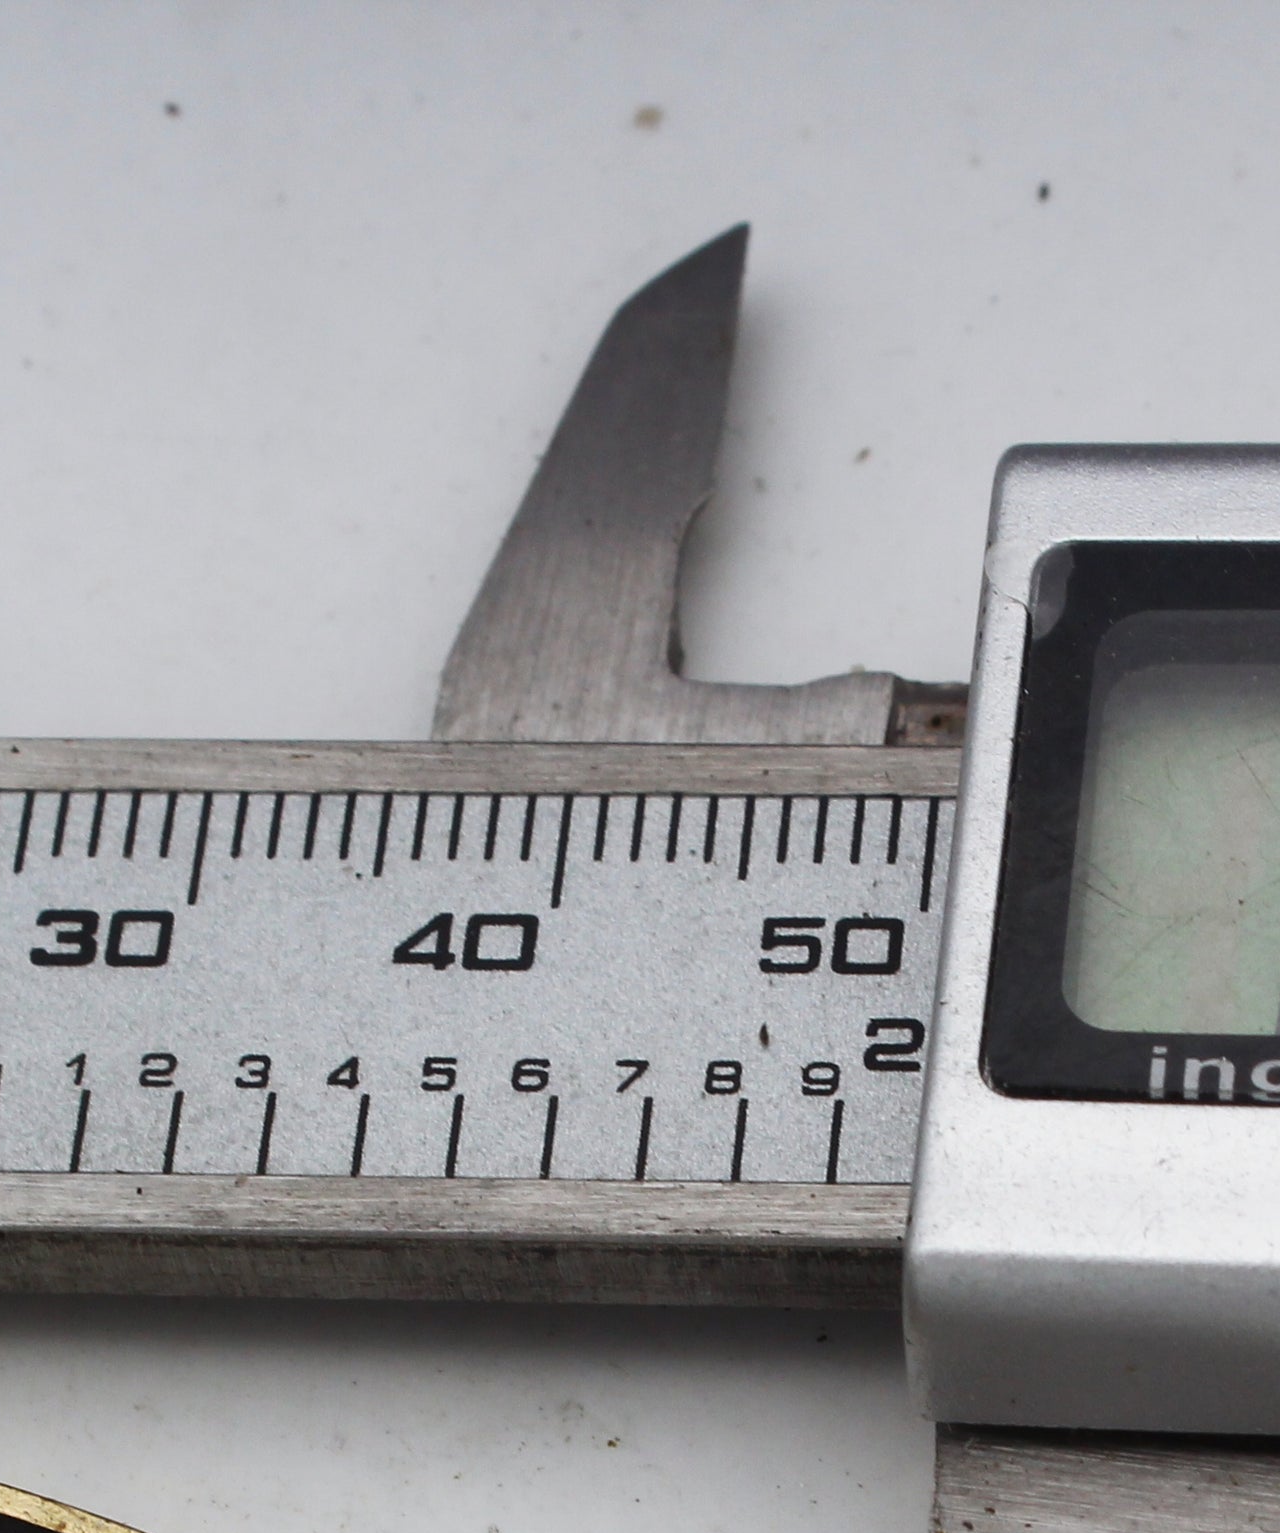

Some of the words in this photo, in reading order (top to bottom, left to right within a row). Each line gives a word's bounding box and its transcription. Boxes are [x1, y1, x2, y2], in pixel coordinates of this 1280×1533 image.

[29, 909, 175, 967] 30
[392, 912, 540, 972] 40
[758, 915, 905, 976] 50
[65, 1053, 86, 1086] 1
[139, 1052, 178, 1088] 2
[235, 1054, 272, 1089] 3
[327, 1056, 360, 1090] 4
[421, 1056, 458, 1092] 5
[511, 1058, 551, 1093] 6
[615, 1060, 650, 1093] 7
[704, 1060, 743, 1096] 8
[801, 1061, 841, 1097] 9
[863, 1017, 924, 1073] 2
